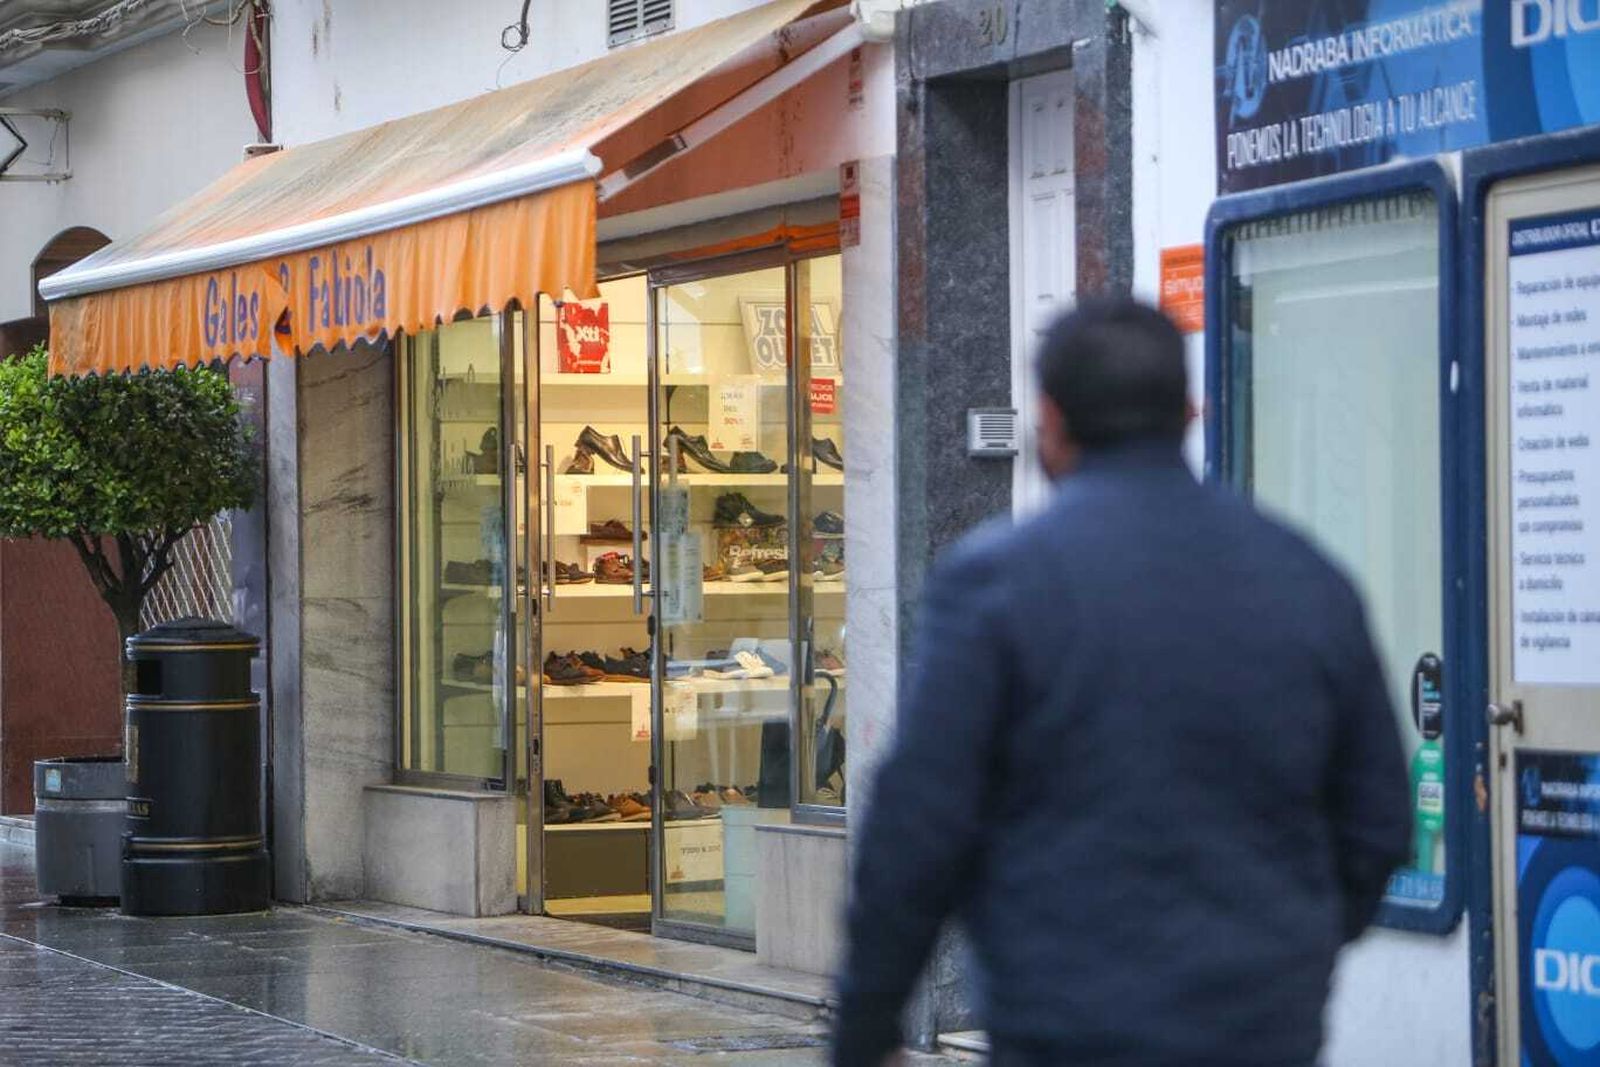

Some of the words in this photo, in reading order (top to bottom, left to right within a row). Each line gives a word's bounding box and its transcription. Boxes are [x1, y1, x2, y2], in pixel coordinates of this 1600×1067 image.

[1268, 34, 1349, 83] NADRABA
[1226, 122, 1281, 169] PONEMOS
[1283, 119, 1299, 158] LA
[1386, 97, 1396, 137] A
[1398, 93, 1416, 133] TU
[1418, 79, 1477, 130] ALCANCE
[204, 271, 259, 348] Gales
[308, 244, 386, 335] Fabiola
